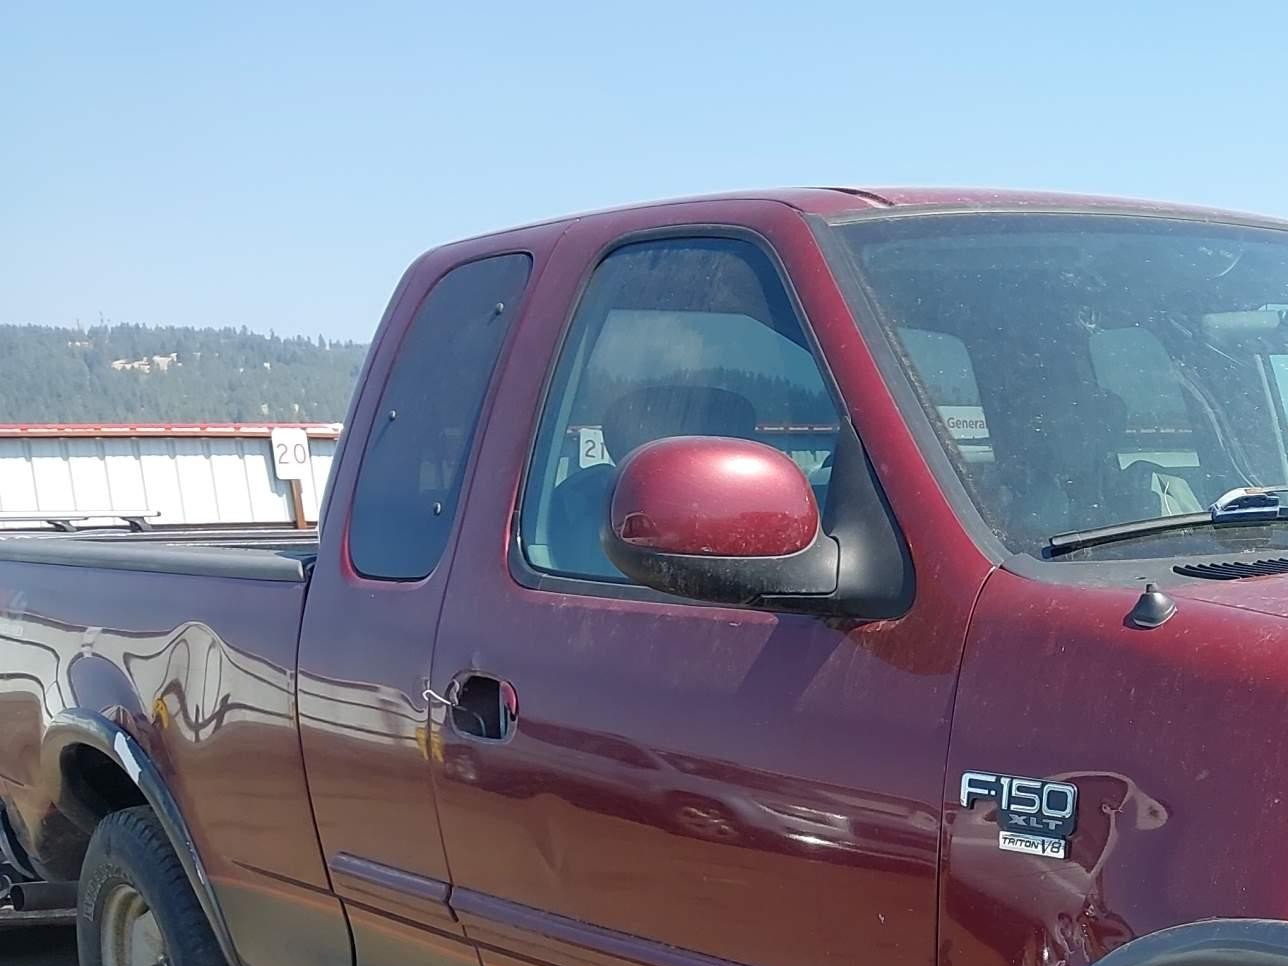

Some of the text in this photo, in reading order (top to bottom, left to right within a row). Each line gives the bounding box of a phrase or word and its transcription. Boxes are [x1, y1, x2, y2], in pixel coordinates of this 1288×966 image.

[276, 443, 306, 464] 20
[585, 439, 605, 460] 21
[1009, 813, 1063, 831] XLT
[1001, 836, 1062, 854] TRITON V8
